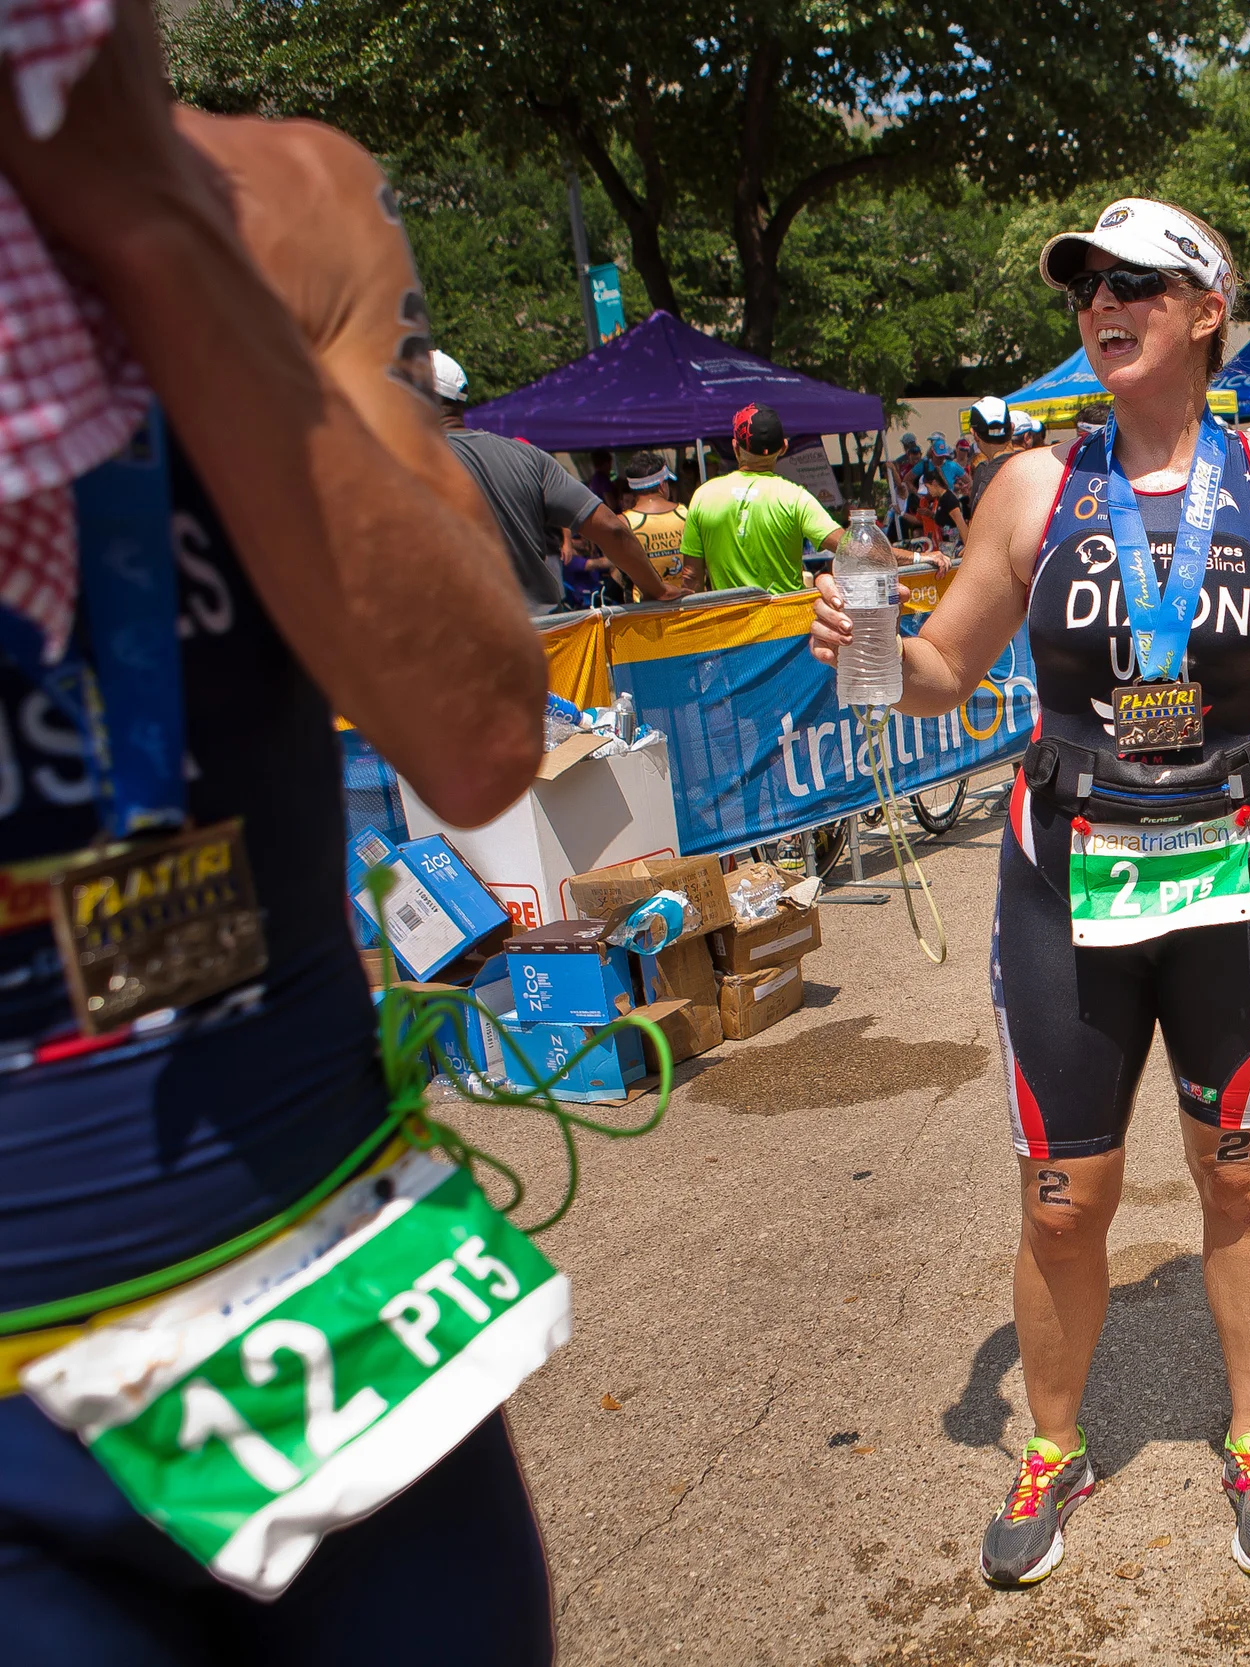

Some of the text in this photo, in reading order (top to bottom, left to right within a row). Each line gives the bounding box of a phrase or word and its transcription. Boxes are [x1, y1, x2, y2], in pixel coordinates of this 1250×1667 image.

[651, 530, 682, 541] BRIAN
[1134, 550, 1155, 611] Finisher
[1205, 557, 1246, 574] Blind
[1066, 580, 1250, 637] DIN
[1119, 689, 1197, 711] PLAYTRI
[1120, 708, 1195, 720] FESTIVAL
[1093, 826, 1230, 853] paratriathlon
[421, 852, 453, 875] zico
[1109, 860, 1216, 917] 2 PT5
[523, 965, 543, 1012] zico
[1036, 1168, 1073, 1206] 2
[179, 1320, 389, 1493] 12
[379, 1235, 520, 1368] PT5
